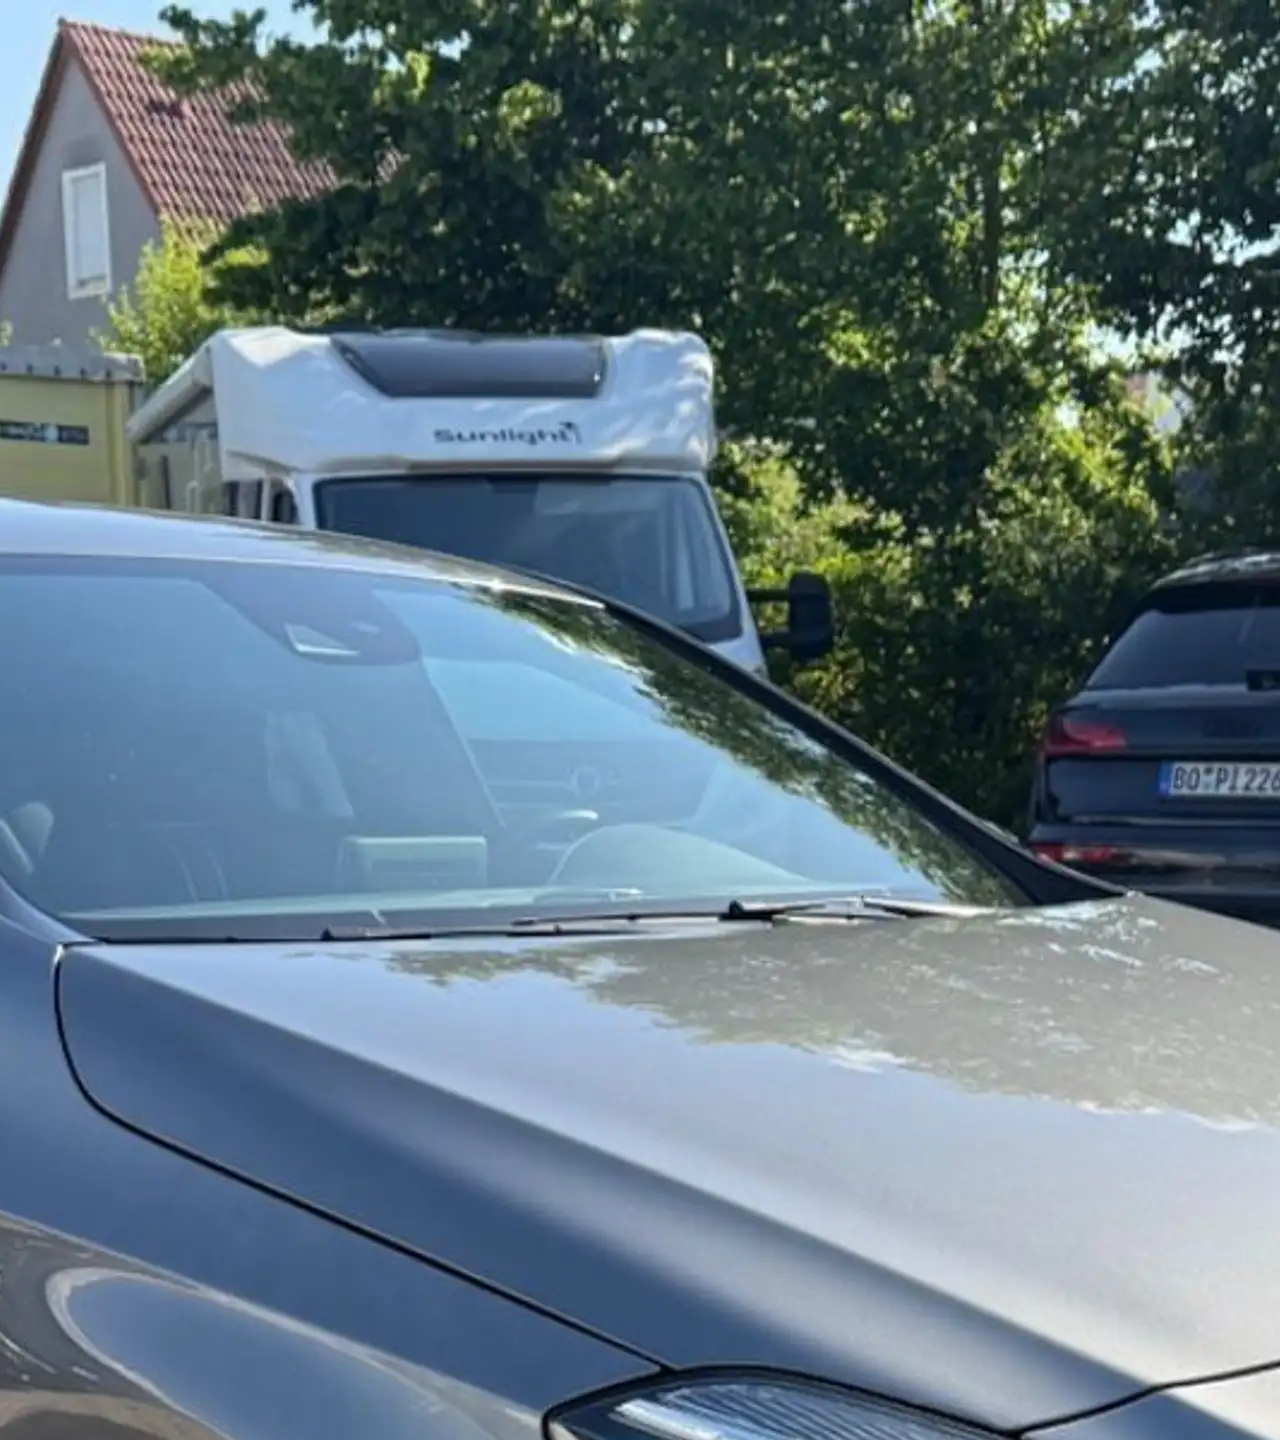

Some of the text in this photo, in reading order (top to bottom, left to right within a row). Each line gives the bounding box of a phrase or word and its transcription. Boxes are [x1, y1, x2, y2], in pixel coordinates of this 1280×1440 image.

[434, 425, 577, 447] Sunlight
[1174, 766, 1201, 790] BO
[1216, 766, 1239, 791] PI
